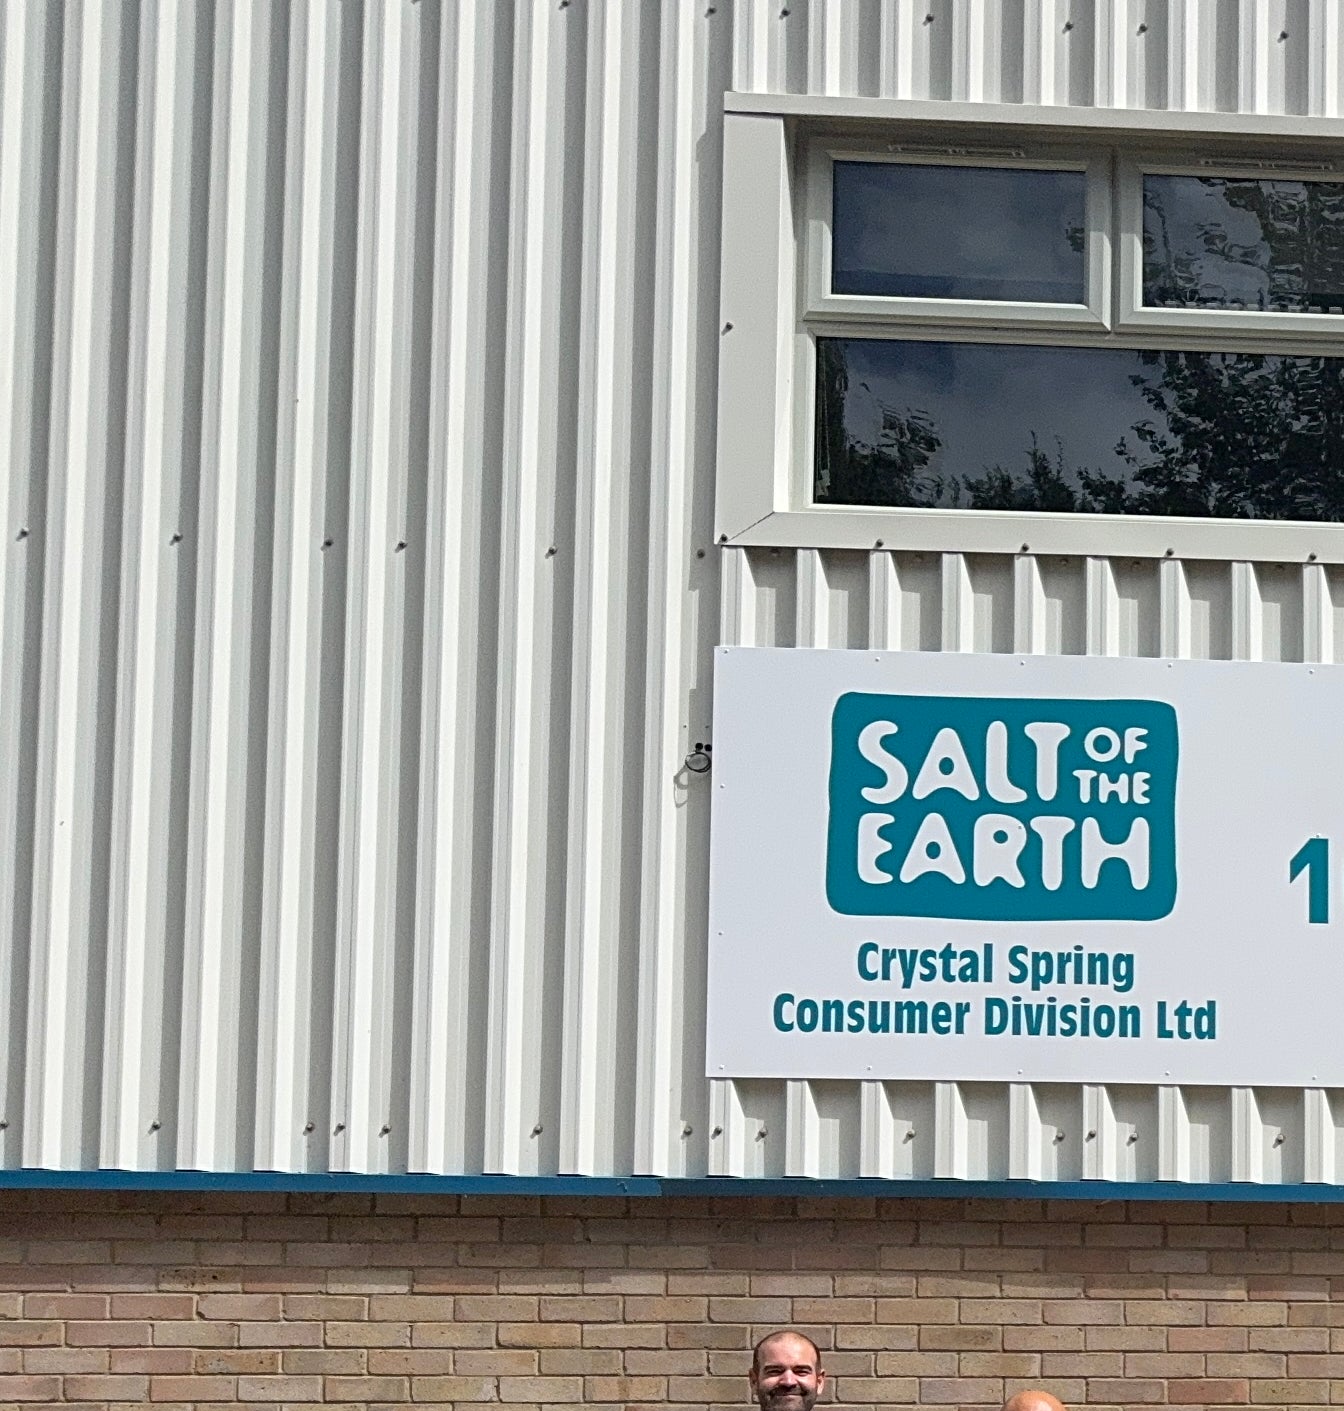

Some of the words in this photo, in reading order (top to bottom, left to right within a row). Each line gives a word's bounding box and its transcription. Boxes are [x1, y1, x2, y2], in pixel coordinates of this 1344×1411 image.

[858, 721, 1070, 804] SALT
[1085, 727, 1148, 763] OF
[1073, 770, 1150, 804] THE
[858, 813, 1149, 890] EARTH
[858, 942, 993, 988] Crystal
[1009, 945, 1134, 992] Spring
[774, 994, 970, 1035] Consumer
[985, 996, 1140, 1037] Division
[1158, 1001, 1216, 1039] Ltd
